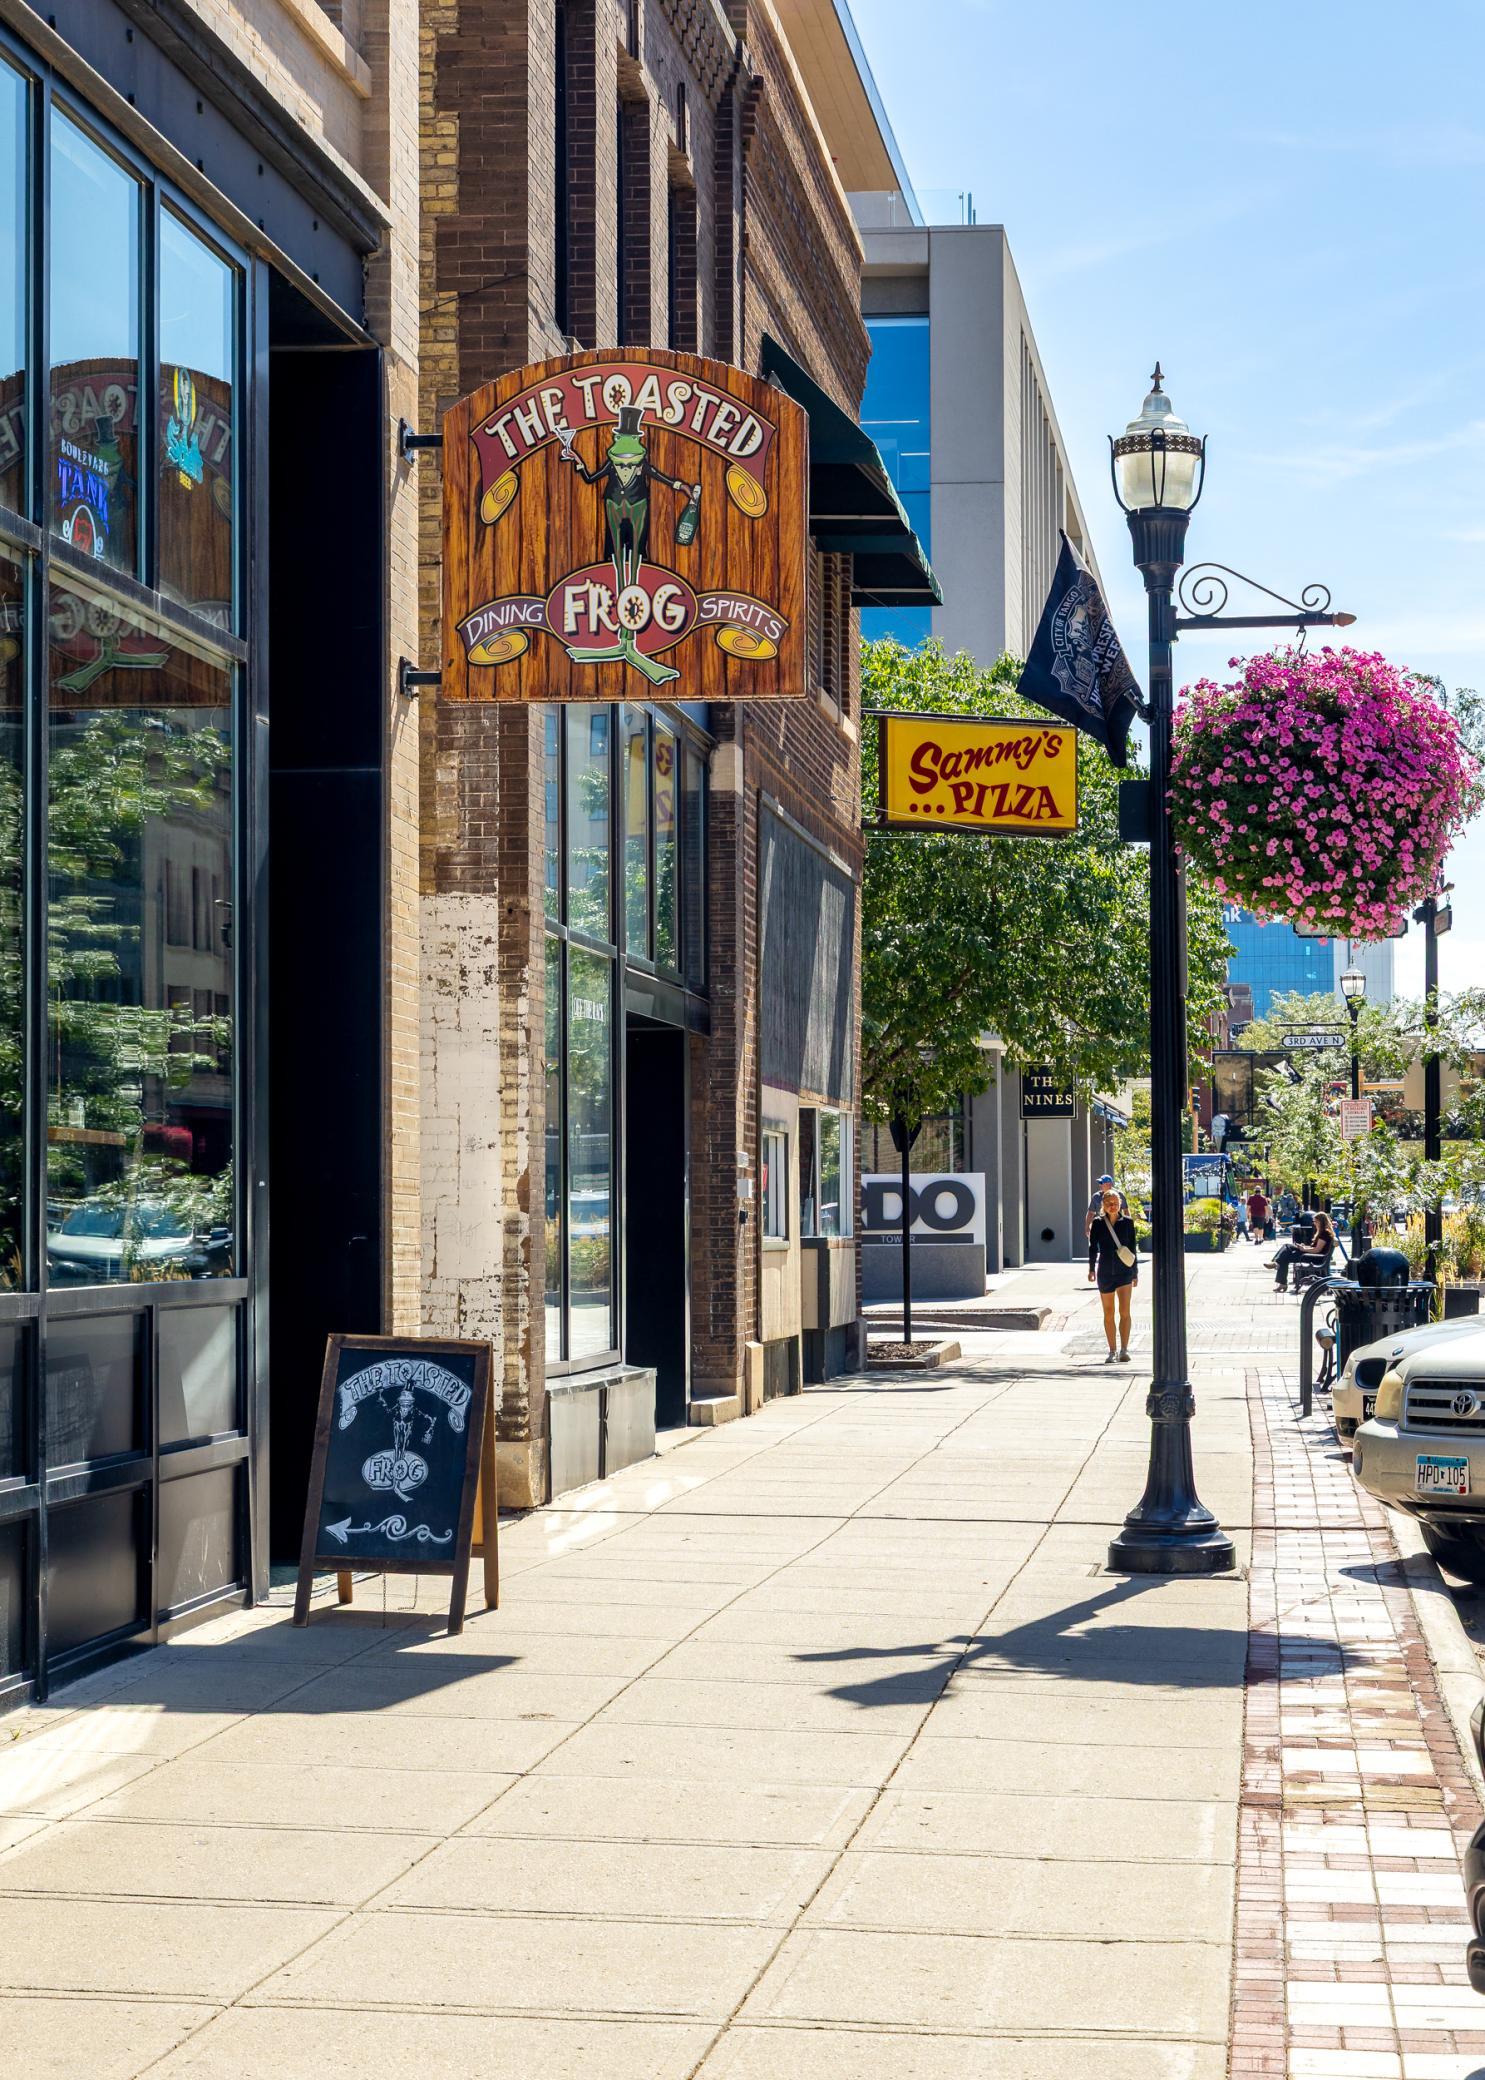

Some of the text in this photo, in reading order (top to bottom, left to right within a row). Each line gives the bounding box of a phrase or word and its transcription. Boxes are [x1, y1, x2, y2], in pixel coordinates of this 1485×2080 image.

[485, 373, 764, 458] THE TOASTED
[58, 457, 110, 535] TANK
[466, 603, 544, 646] DINING
[562, 577, 687, 634] FROG
[699, 597, 783, 640] SPIRITS
[1055, 591, 1079, 647] CITY OF FARGO
[908, 730, 1063, 795] Sammy's
[1288, 1036, 1340, 1046] 3RD AVE N
[1023, 1094, 1073, 1106] NINES
[1030, 1076, 1055, 1088] TH
[880, 1234, 917, 1245] TOWR
[345, 1361, 470, 1406] THE TOASTED
[367, 1456, 425, 1482] FROG
[1417, 1464, 1466, 1486] HPD 105
